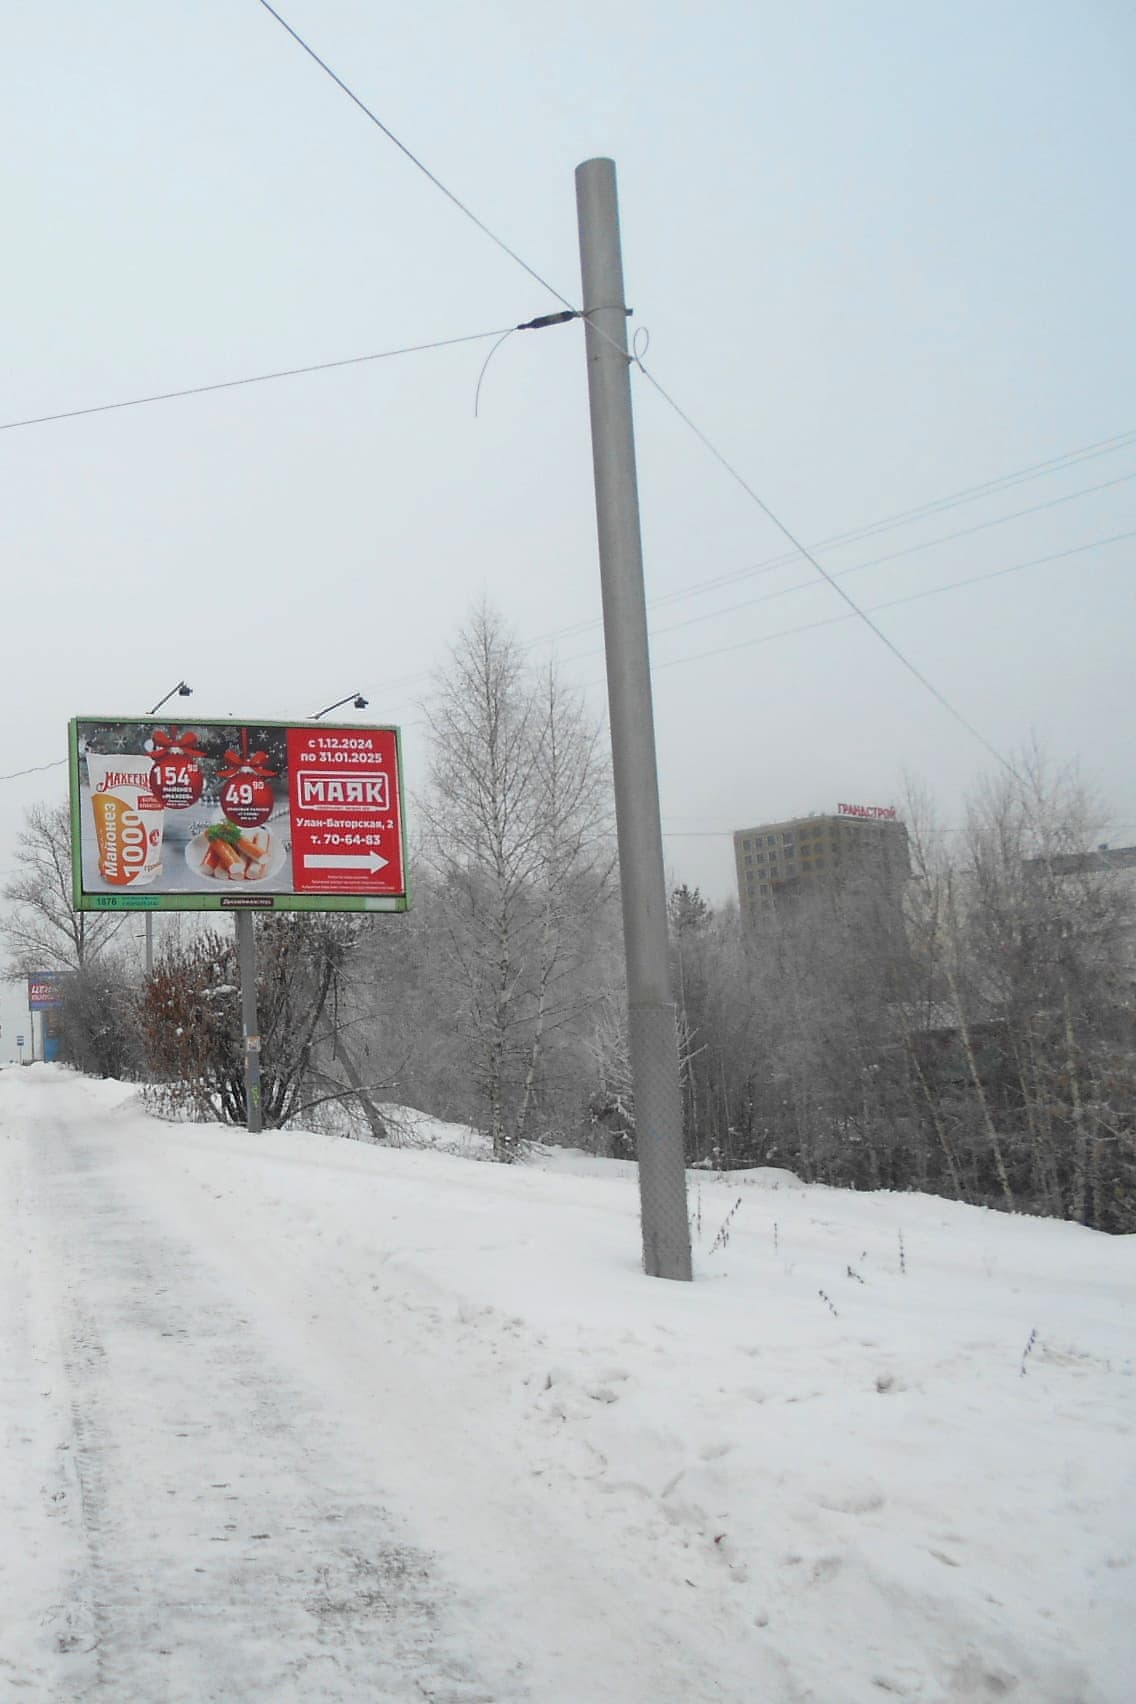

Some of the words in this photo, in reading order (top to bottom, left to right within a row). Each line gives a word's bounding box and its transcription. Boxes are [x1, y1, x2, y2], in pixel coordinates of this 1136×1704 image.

[308, 740, 316, 748] с
[318, 738, 373, 750] 1.12.2024
[300, 752, 316, 762] по
[319, 752, 382, 763] 31.01.2025
[154, 765, 189, 785] 154
[225, 784, 253, 804] 49
[303, 781, 384, 803] МАЯК
[838, 803, 896, 817] ГРАНДСТРОЙ
[296, 818, 385, 831] Улан-Баторская,
[387, 820, 394, 829] 2
[104, 803, 118, 877] Майонез
[120, 810, 144, 877] 1000
[310, 835, 321, 844] т.
